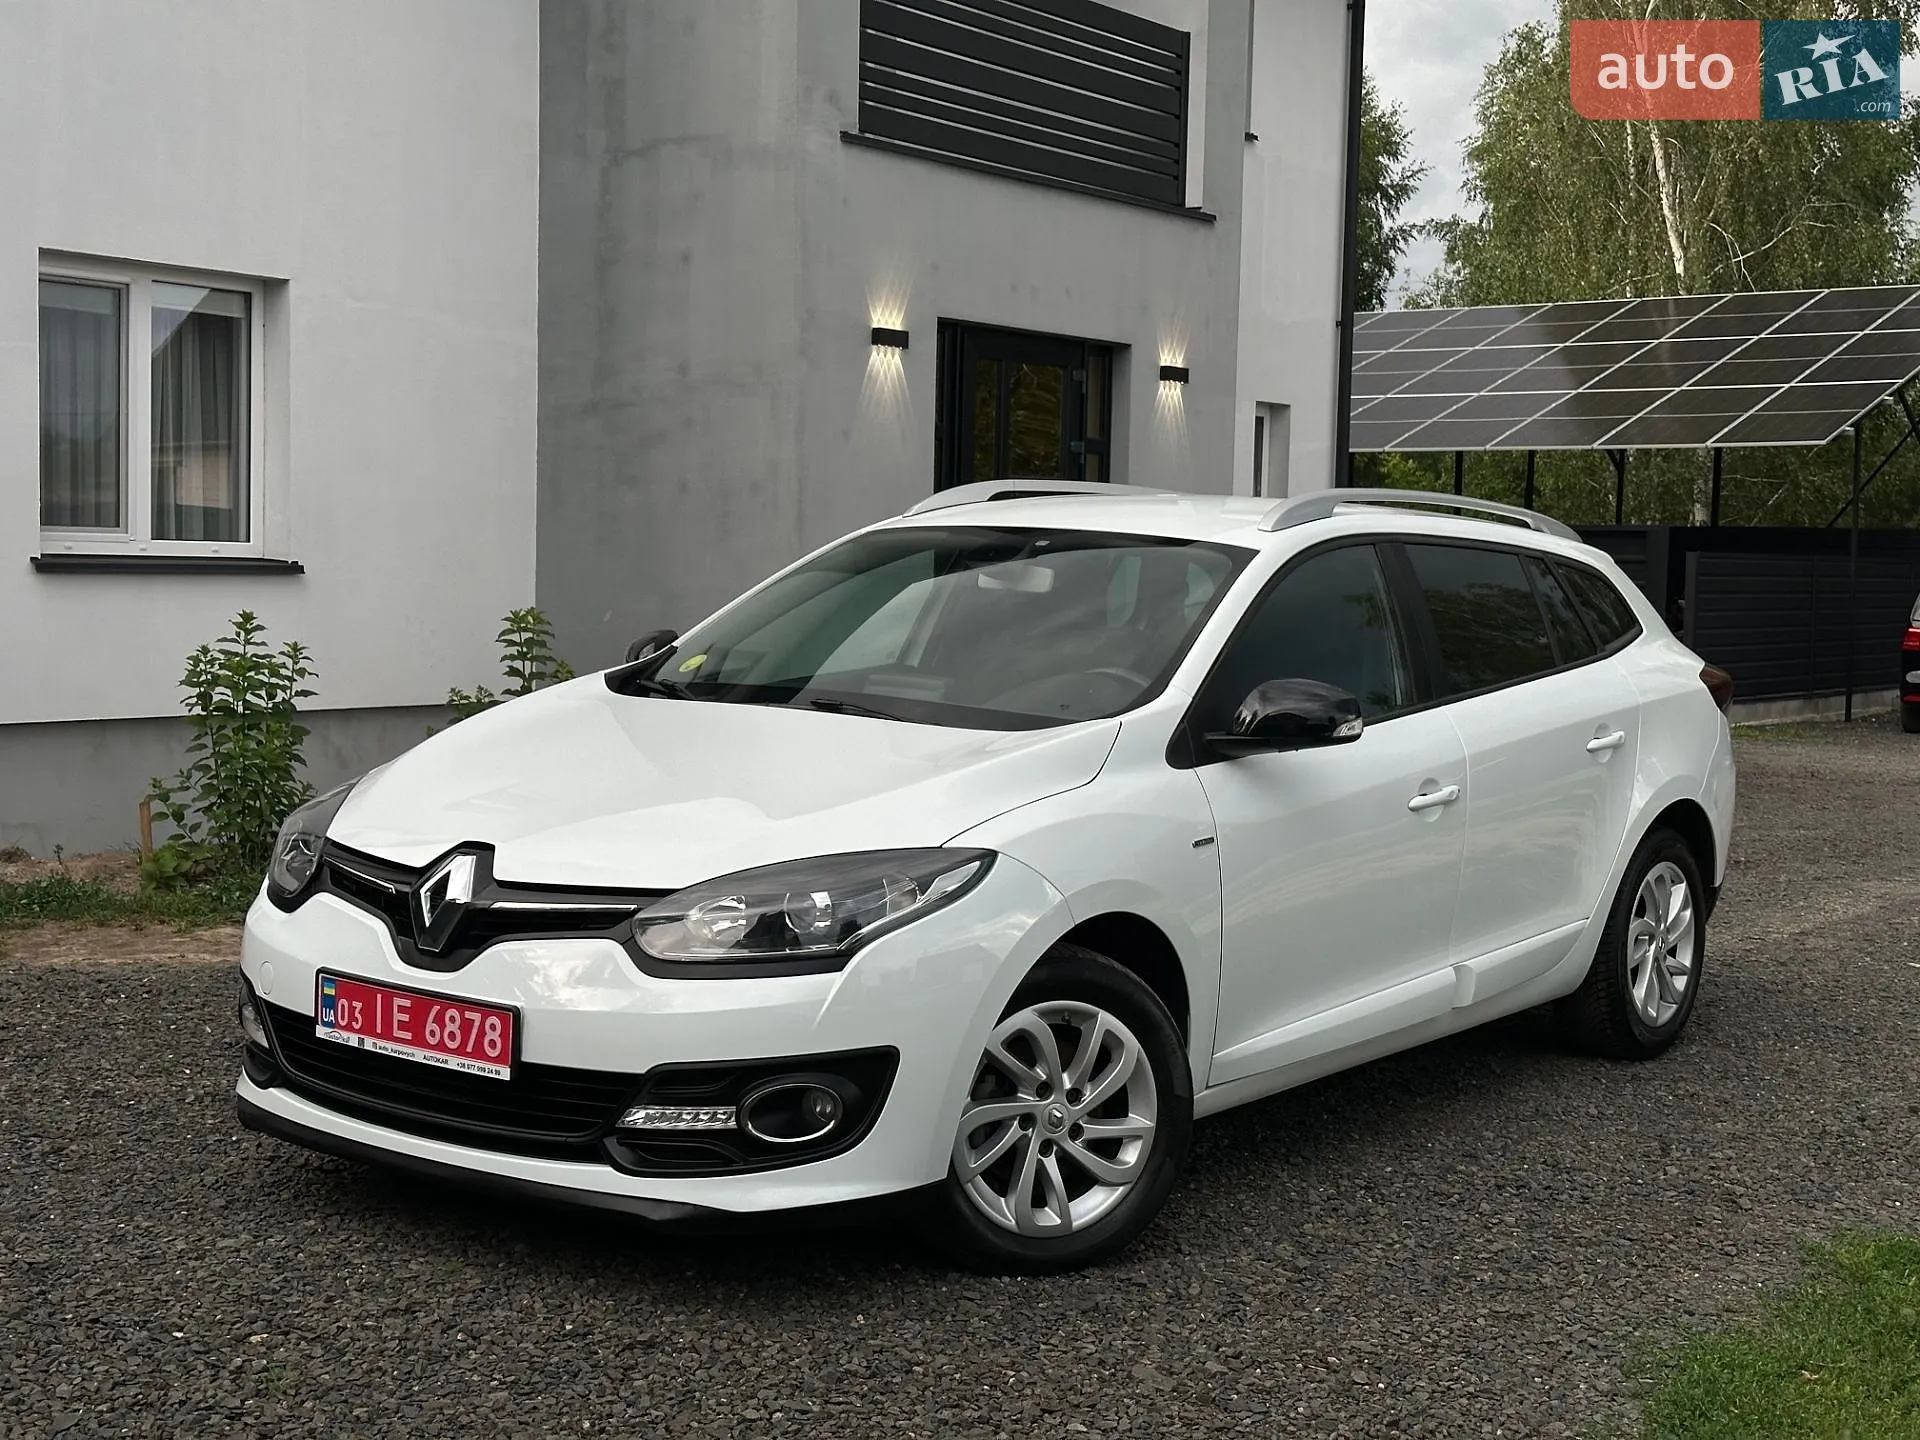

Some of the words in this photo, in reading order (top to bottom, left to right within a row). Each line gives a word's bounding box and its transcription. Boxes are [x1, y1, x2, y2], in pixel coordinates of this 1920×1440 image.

[323, 1008, 336, 1024] UA
[337, 998, 363, 1030] 03
[376, 993, 413, 1040] IE
[425, 1005, 502, 1058] 6878
